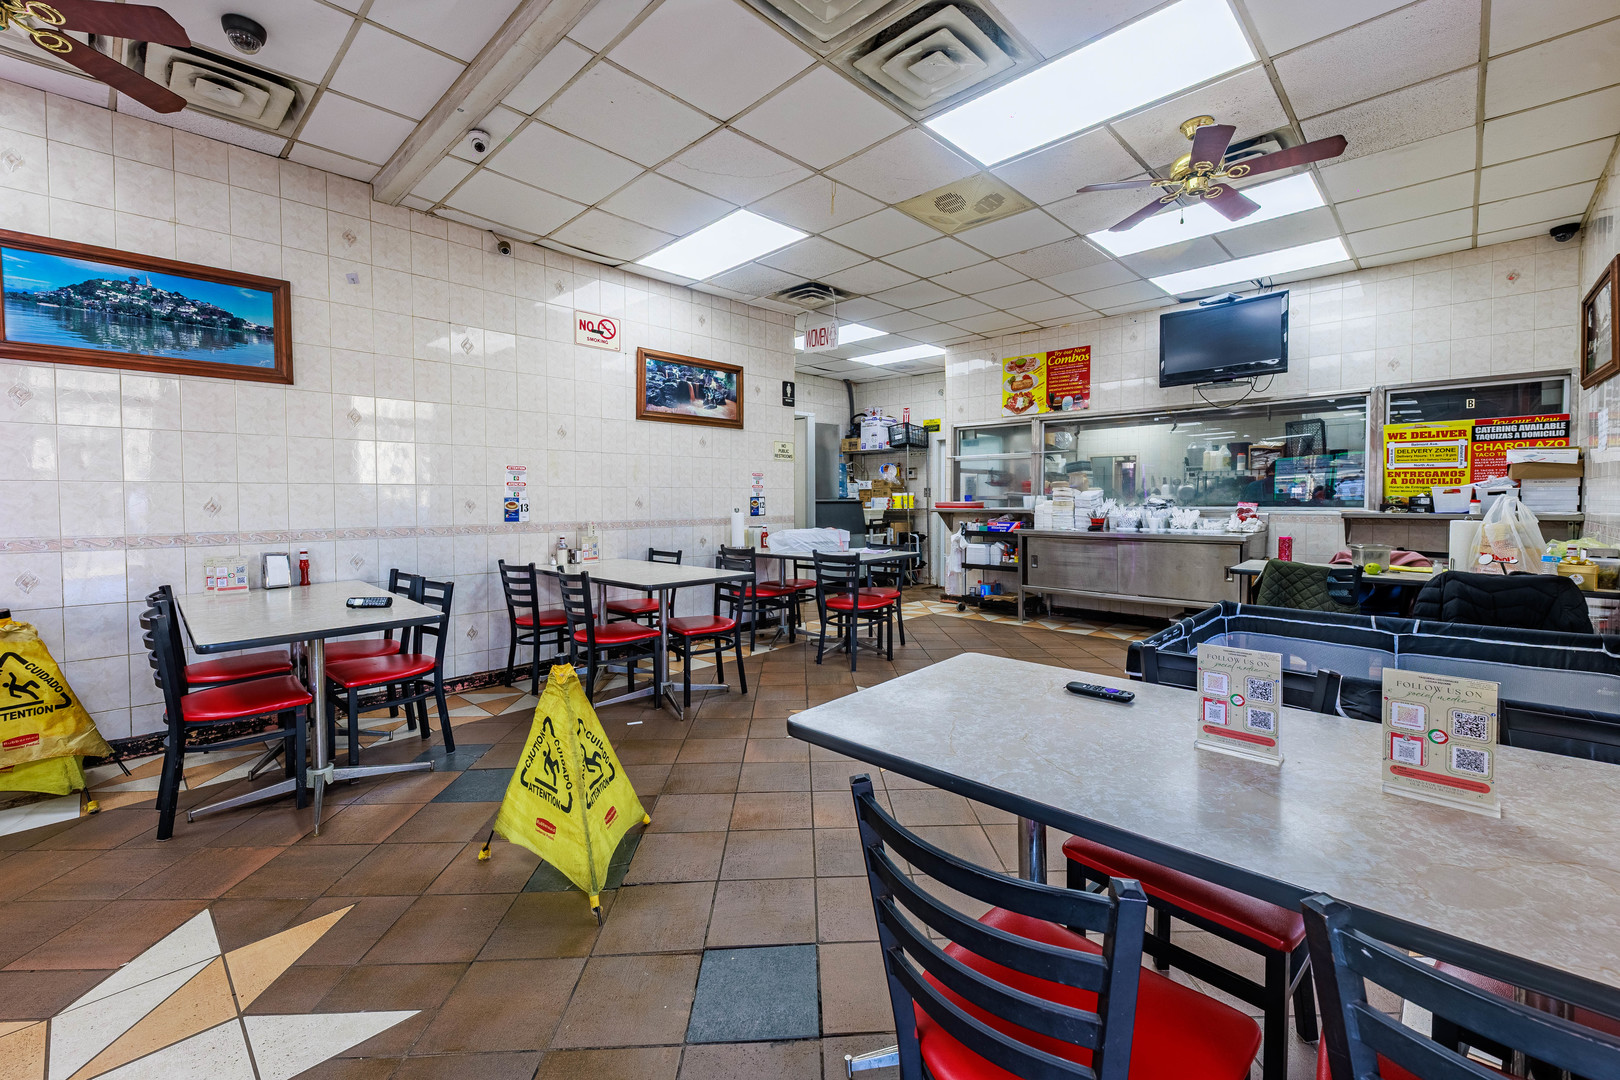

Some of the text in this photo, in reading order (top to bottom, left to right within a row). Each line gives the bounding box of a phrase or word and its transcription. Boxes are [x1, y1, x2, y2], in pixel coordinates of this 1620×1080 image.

[579, 319, 594, 332] NO
[586, 336, 609, 345] SMOKING
[805, 327, 829, 348] WOMEN
[1047, 352, 1090, 366] Combos
[1467, 400, 1474, 408] B
[1475, 421, 1566, 434] CATERING AVAILABLE
[1387, 429, 1467, 440] WE DELIVER
[1475, 432, 1513, 441] TAQUIZAS
[1521, 429, 1565, 438] DOMICILIO
[1387, 470, 1466, 478] ENTREGAMOS
[1401, 477, 1461, 485] DOMICILIO
[520, 503, 530, 513] 13
[1206, 653, 1240, 664] FOLLOW
[1243, 658, 1255, 666] US
[1256, 660, 1270, 668] ON
[25, 662, 64, 694] CUIDADO
[1396, 680, 1483, 699] FOLLOW US ON
[0, 704, 54, 722] TENTION
[525, 729, 546, 769] CAUTION
[554, 739, 573, 790] CUIDADO
[528, 782, 561, 810] ATTENTION
